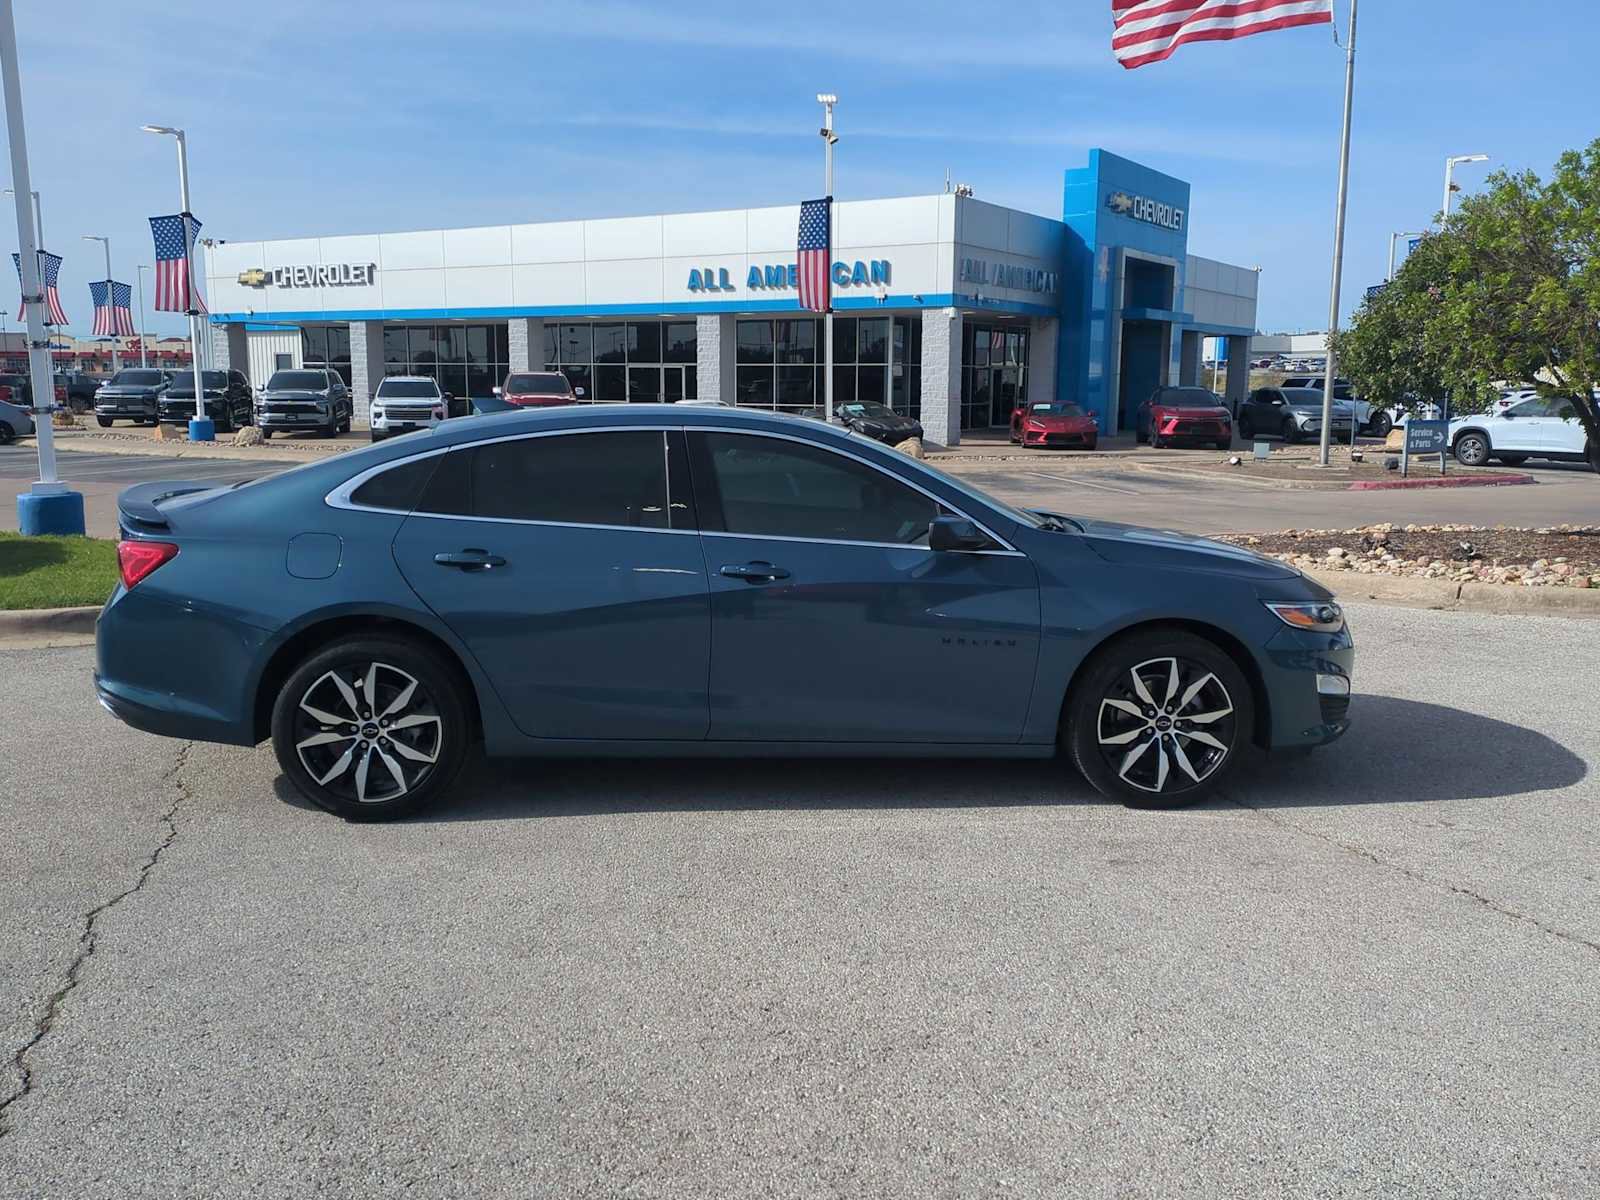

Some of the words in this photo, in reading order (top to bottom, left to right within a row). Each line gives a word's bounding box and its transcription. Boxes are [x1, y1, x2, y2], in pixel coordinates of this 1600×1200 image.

[1134, 196, 1184, 230] CHEVROLET
[271, 263, 375, 288] CHEVROLET
[688, 268, 735, 292] ALL
[747, 260, 891, 290] AMECAN
[960, 257, 988, 285] ALL
[1410, 428, 1433, 437] Service
[1415, 439, 1431, 448] Parts
